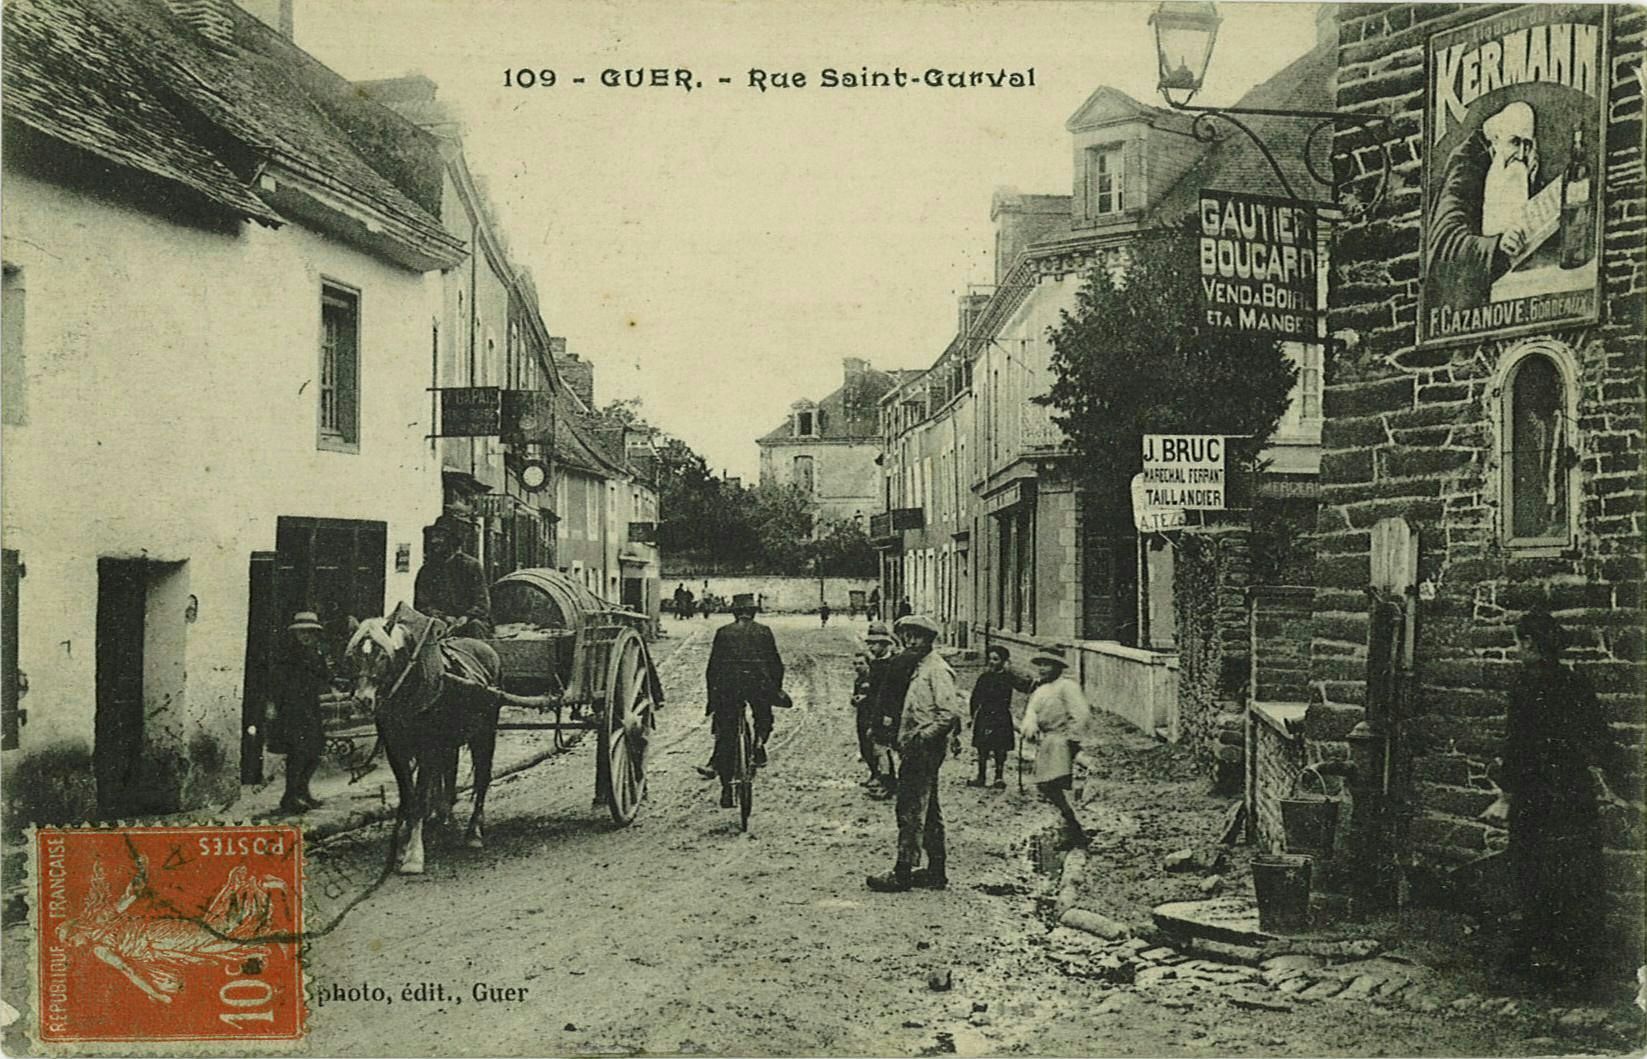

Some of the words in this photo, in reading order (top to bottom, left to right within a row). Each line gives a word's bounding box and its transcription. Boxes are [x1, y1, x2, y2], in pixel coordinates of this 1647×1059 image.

[1434, 23, 1599, 147] KERMANN
[1201, 277, 1252, 305] VEND
[1146, 489, 1222, 506] TAILLANDIER
[199, 836, 285, 857] POSTES
[48, 837, 66, 919] FRANÇAISE
[49, 946, 68, 1033] REPUBLIQUE
